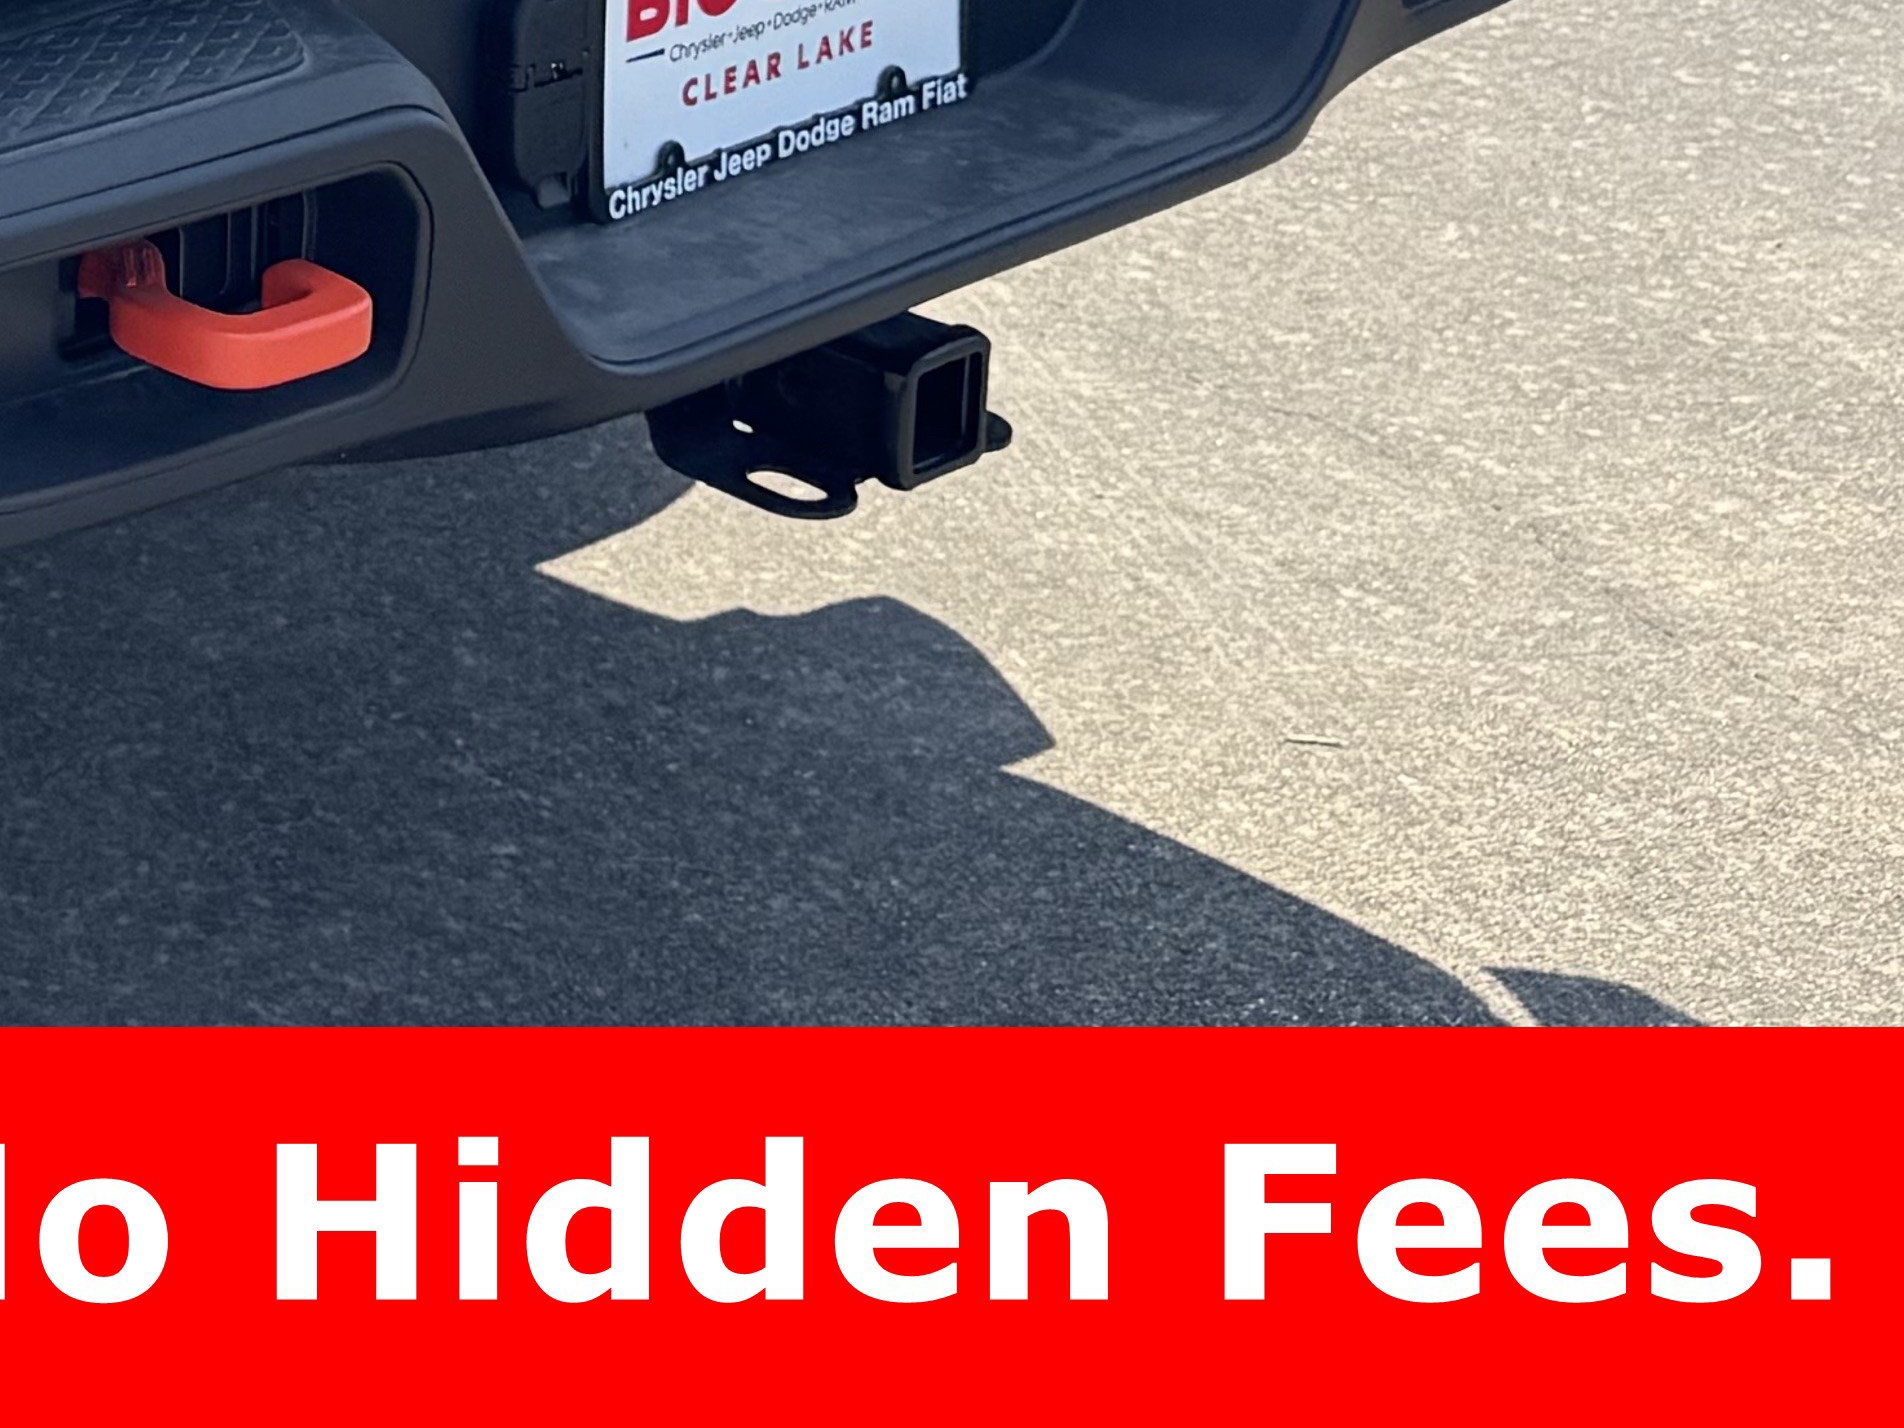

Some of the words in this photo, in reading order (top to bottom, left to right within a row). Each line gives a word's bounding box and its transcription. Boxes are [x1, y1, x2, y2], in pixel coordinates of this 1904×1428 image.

[669, 30, 729, 63] Chrysler
[681, 51, 782, 107] CLEAR
[797, 20, 874, 70] LAKE
[608, 160, 709, 221] Chrysler
[713, 142, 772, 186] Jeep
[778, 110, 856, 158] Dodge
[861, 94, 915, 130] Ram
[922, 73, 968, 112] Fiat
